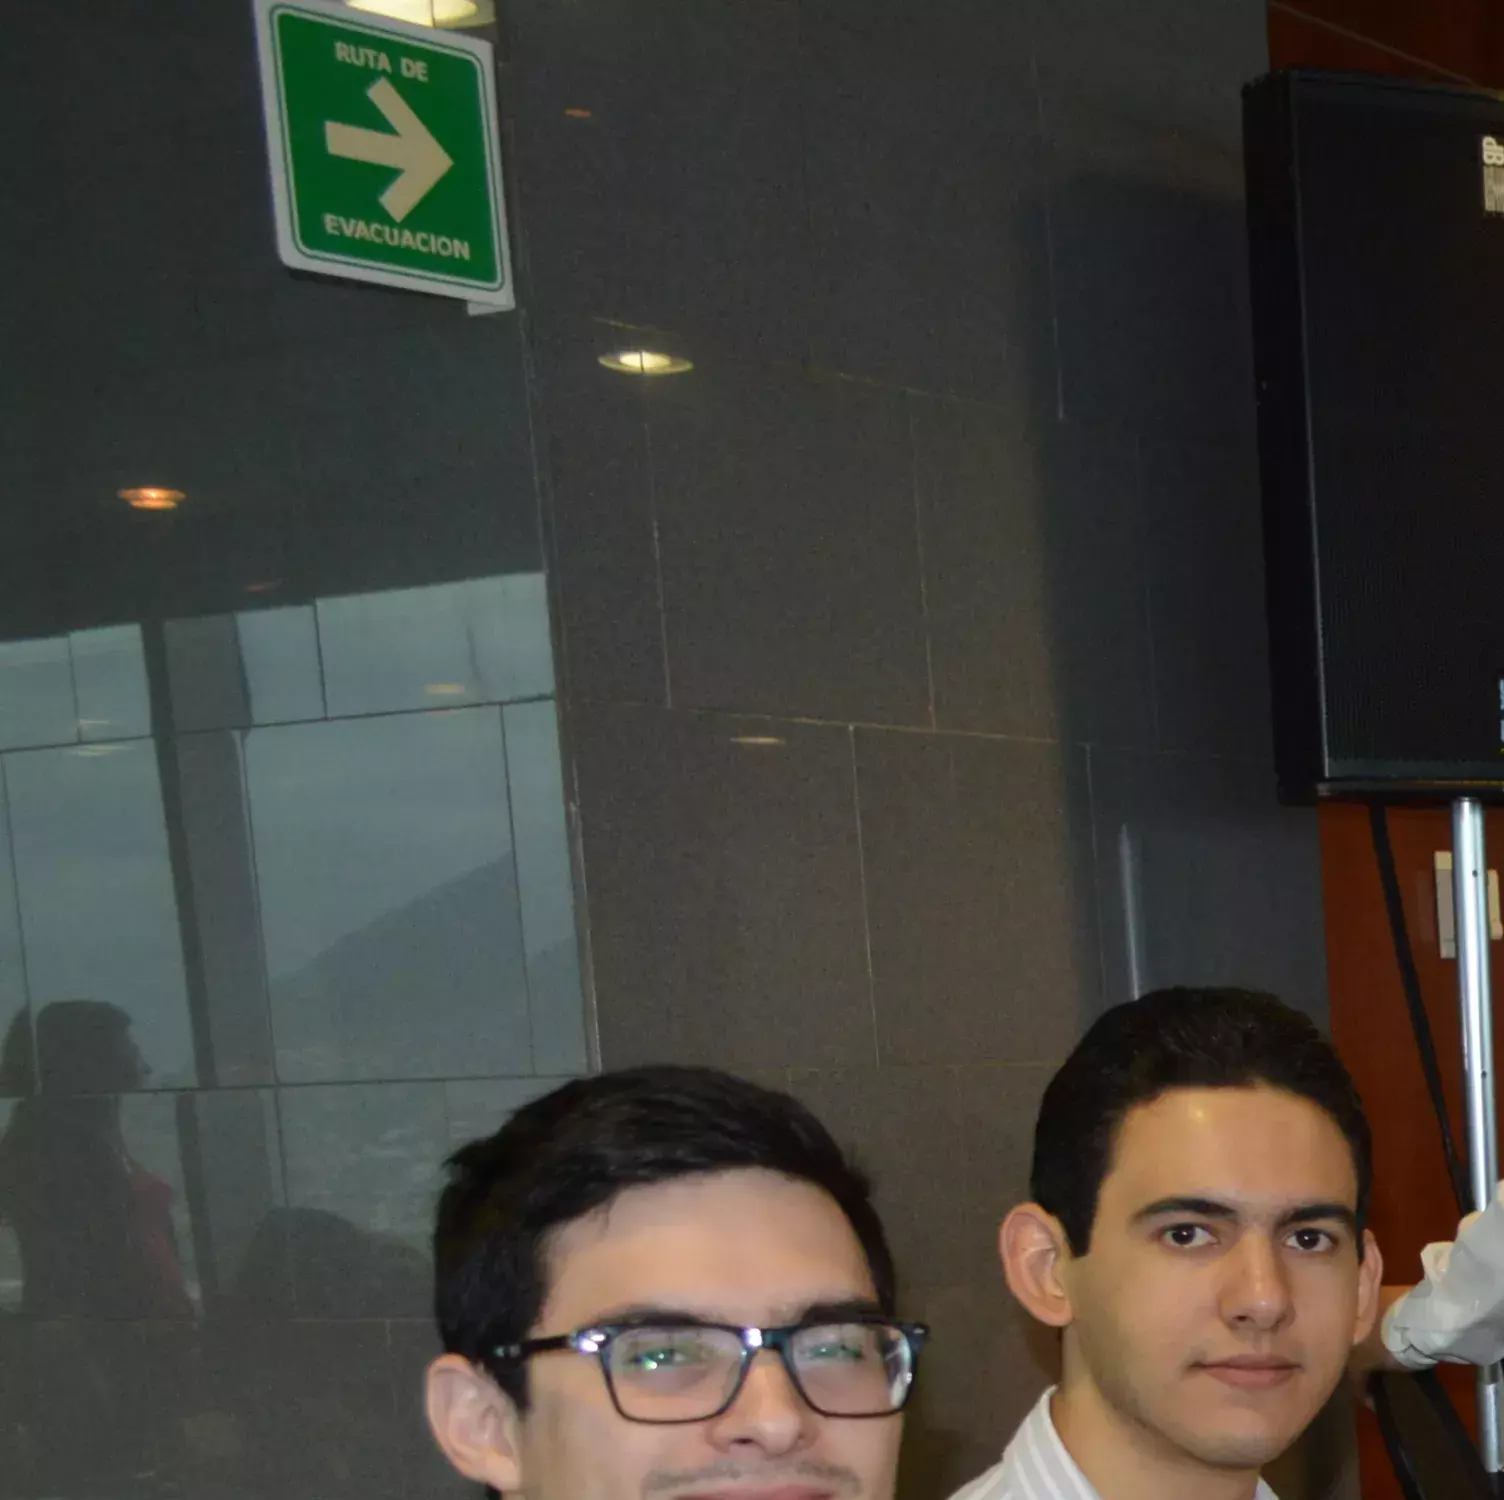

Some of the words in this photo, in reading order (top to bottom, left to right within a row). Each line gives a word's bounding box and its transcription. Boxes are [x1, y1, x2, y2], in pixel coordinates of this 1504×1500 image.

[334, 41, 392, 74] RUTA
[400, 56, 429, 82] DE
[323, 212, 470, 260] EVACUACION
